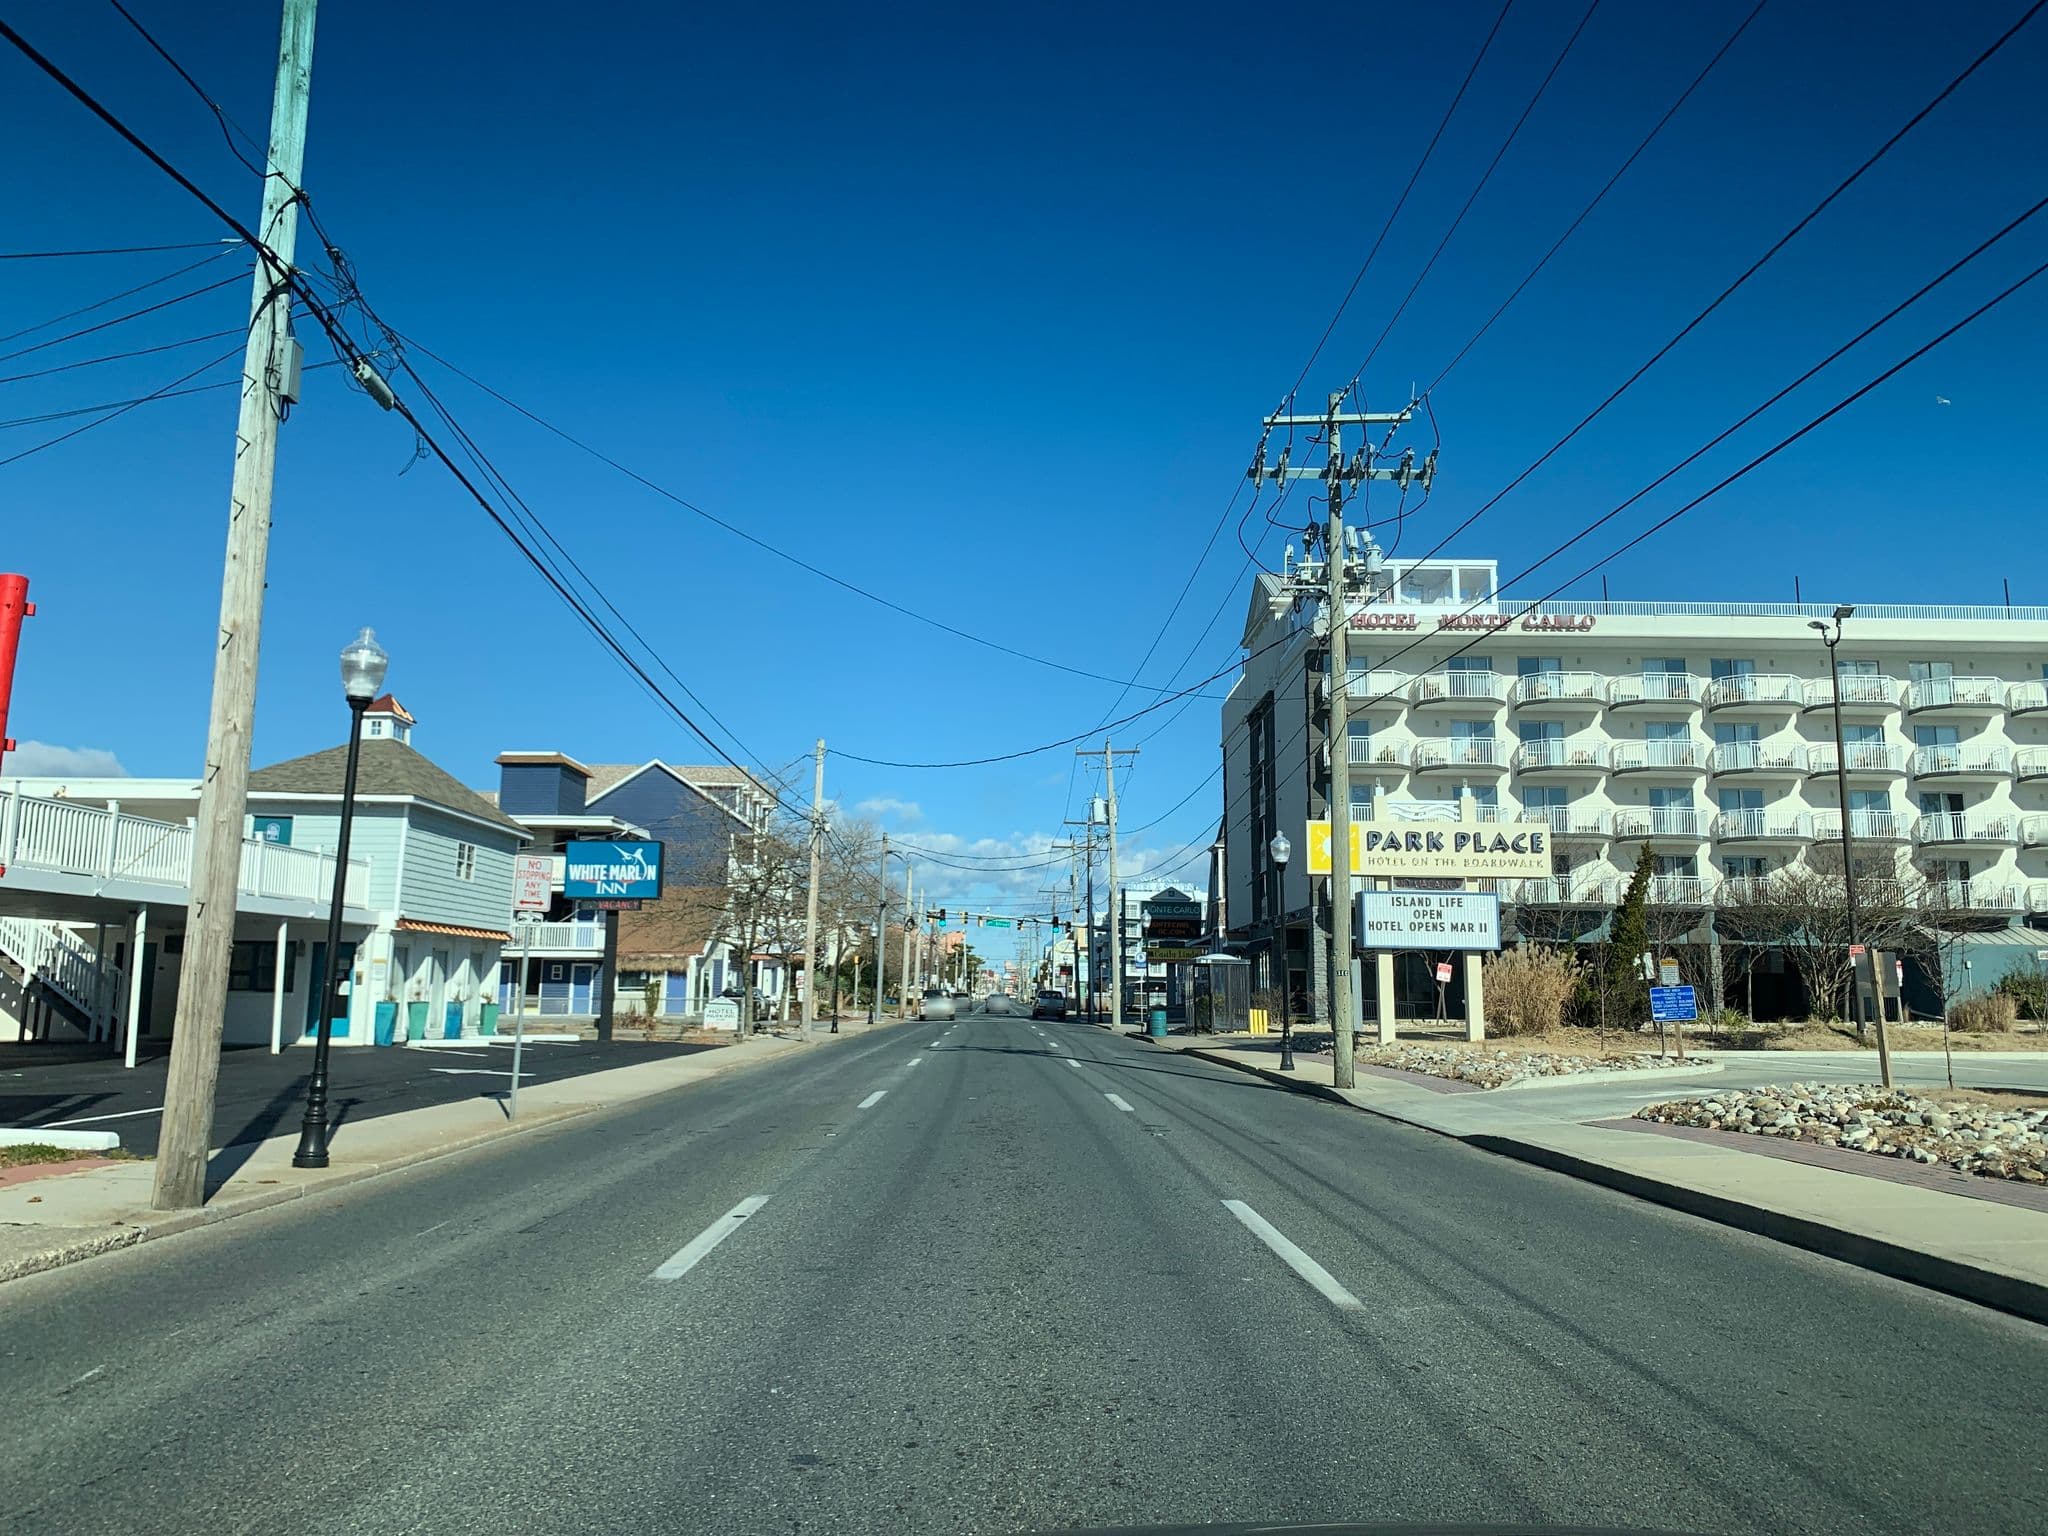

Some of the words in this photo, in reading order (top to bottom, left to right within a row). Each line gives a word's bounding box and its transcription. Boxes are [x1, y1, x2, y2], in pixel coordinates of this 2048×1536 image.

[1351, 613, 1419, 629] HOTEL
[1439, 613, 1513, 629] MONTE
[1366, 830, 1445, 852] PARK
[1454, 831, 1545, 854] PLACE
[528, 860, 543, 869] NO
[1368, 856, 1407, 867] HOTEL
[1412, 857, 1428, 867] ON
[1434, 857, 1457, 867] THE
[1464, 858, 1544, 869] BOARDWALK
[518, 870, 550, 882] STOPPING
[568, 864, 608, 881] WHITE
[525, 882, 542, 890] ANY
[596, 881, 627, 895] INN
[524, 890, 542, 898] TIME
[598, 900, 640, 910] VACANCY
[1391, 896, 1432, 907] ISLAND
[1439, 897, 1464, 908] LIFE
[1173, 905, 1201, 915] CARLO
[1413, 909, 1443, 920] OPEN
[1368, 920, 1403, 932] HOTEL
[1409, 921, 1446, 932] OPENS
[1450, 922, 1474, 933] MAR
